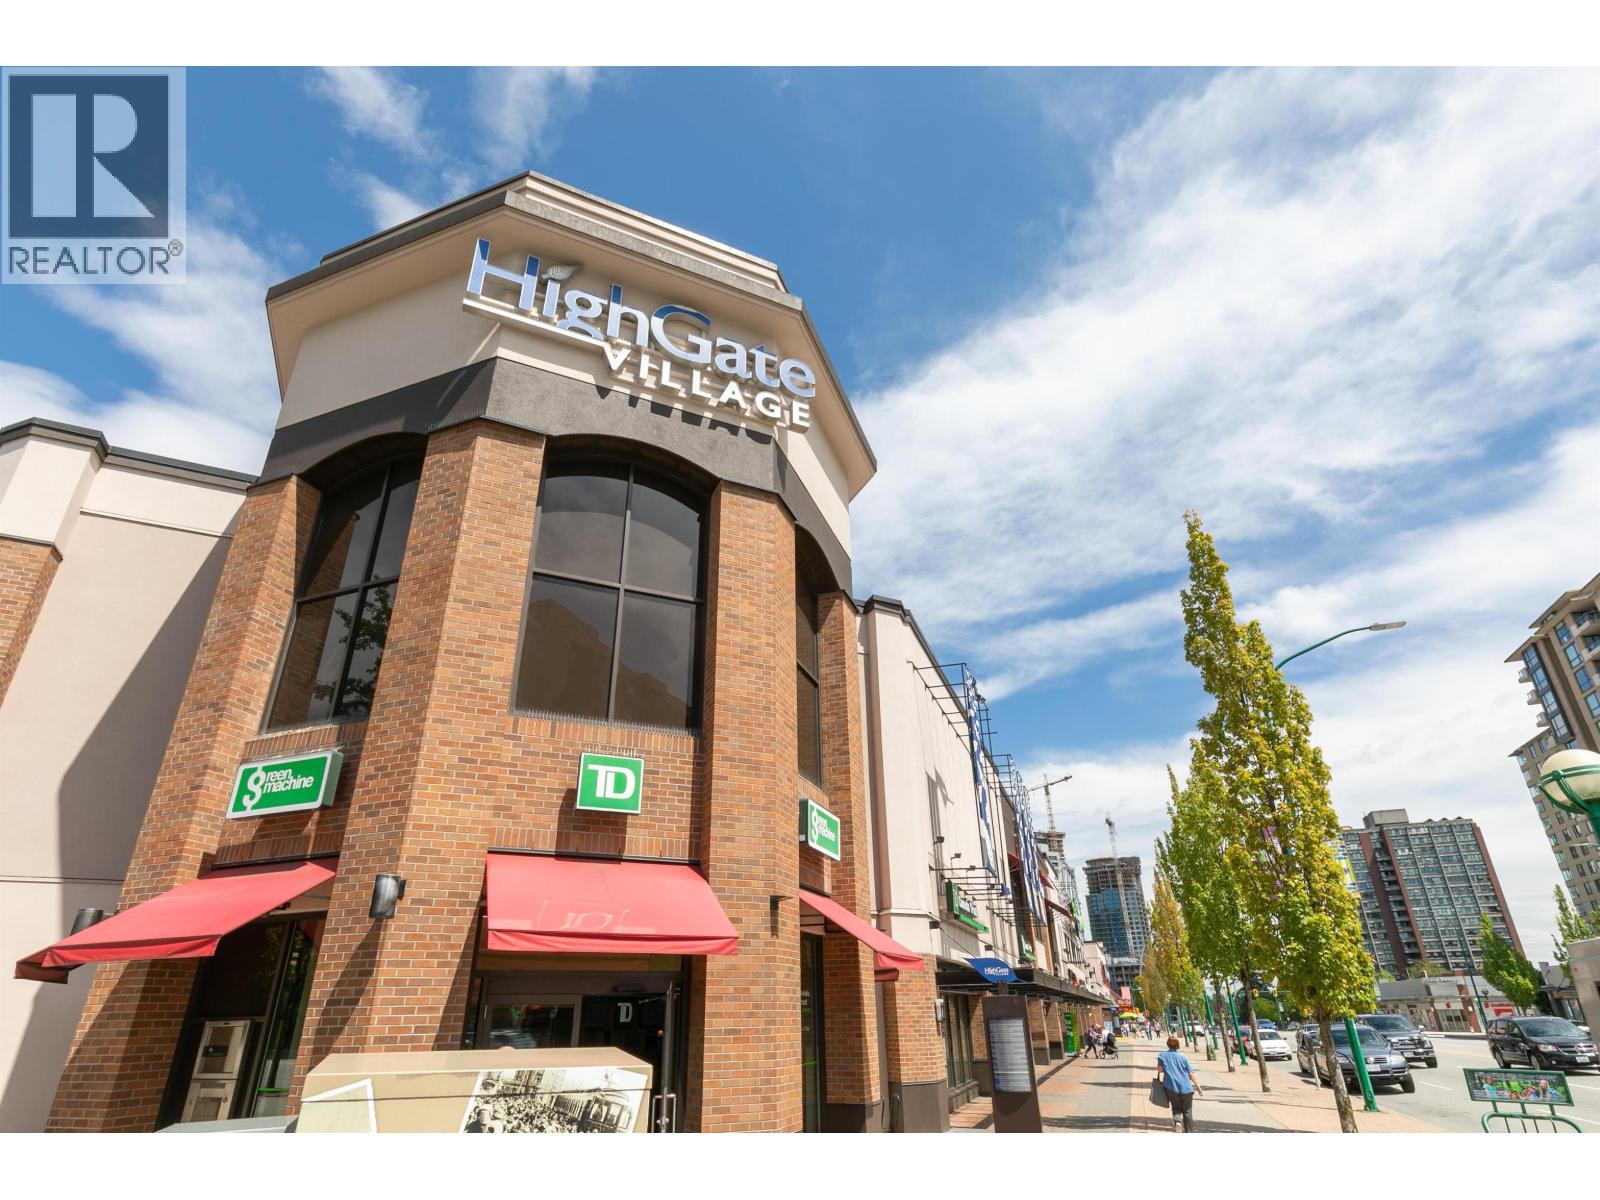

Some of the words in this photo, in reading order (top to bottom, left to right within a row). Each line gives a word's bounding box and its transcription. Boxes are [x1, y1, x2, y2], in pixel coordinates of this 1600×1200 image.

[467, 238, 816, 398] HighGate
[601, 342, 811, 429] VILLAGE
[262, 774, 314, 794] machine
[588, 764, 636, 800] TD
[617, 1002, 633, 1023] TD
